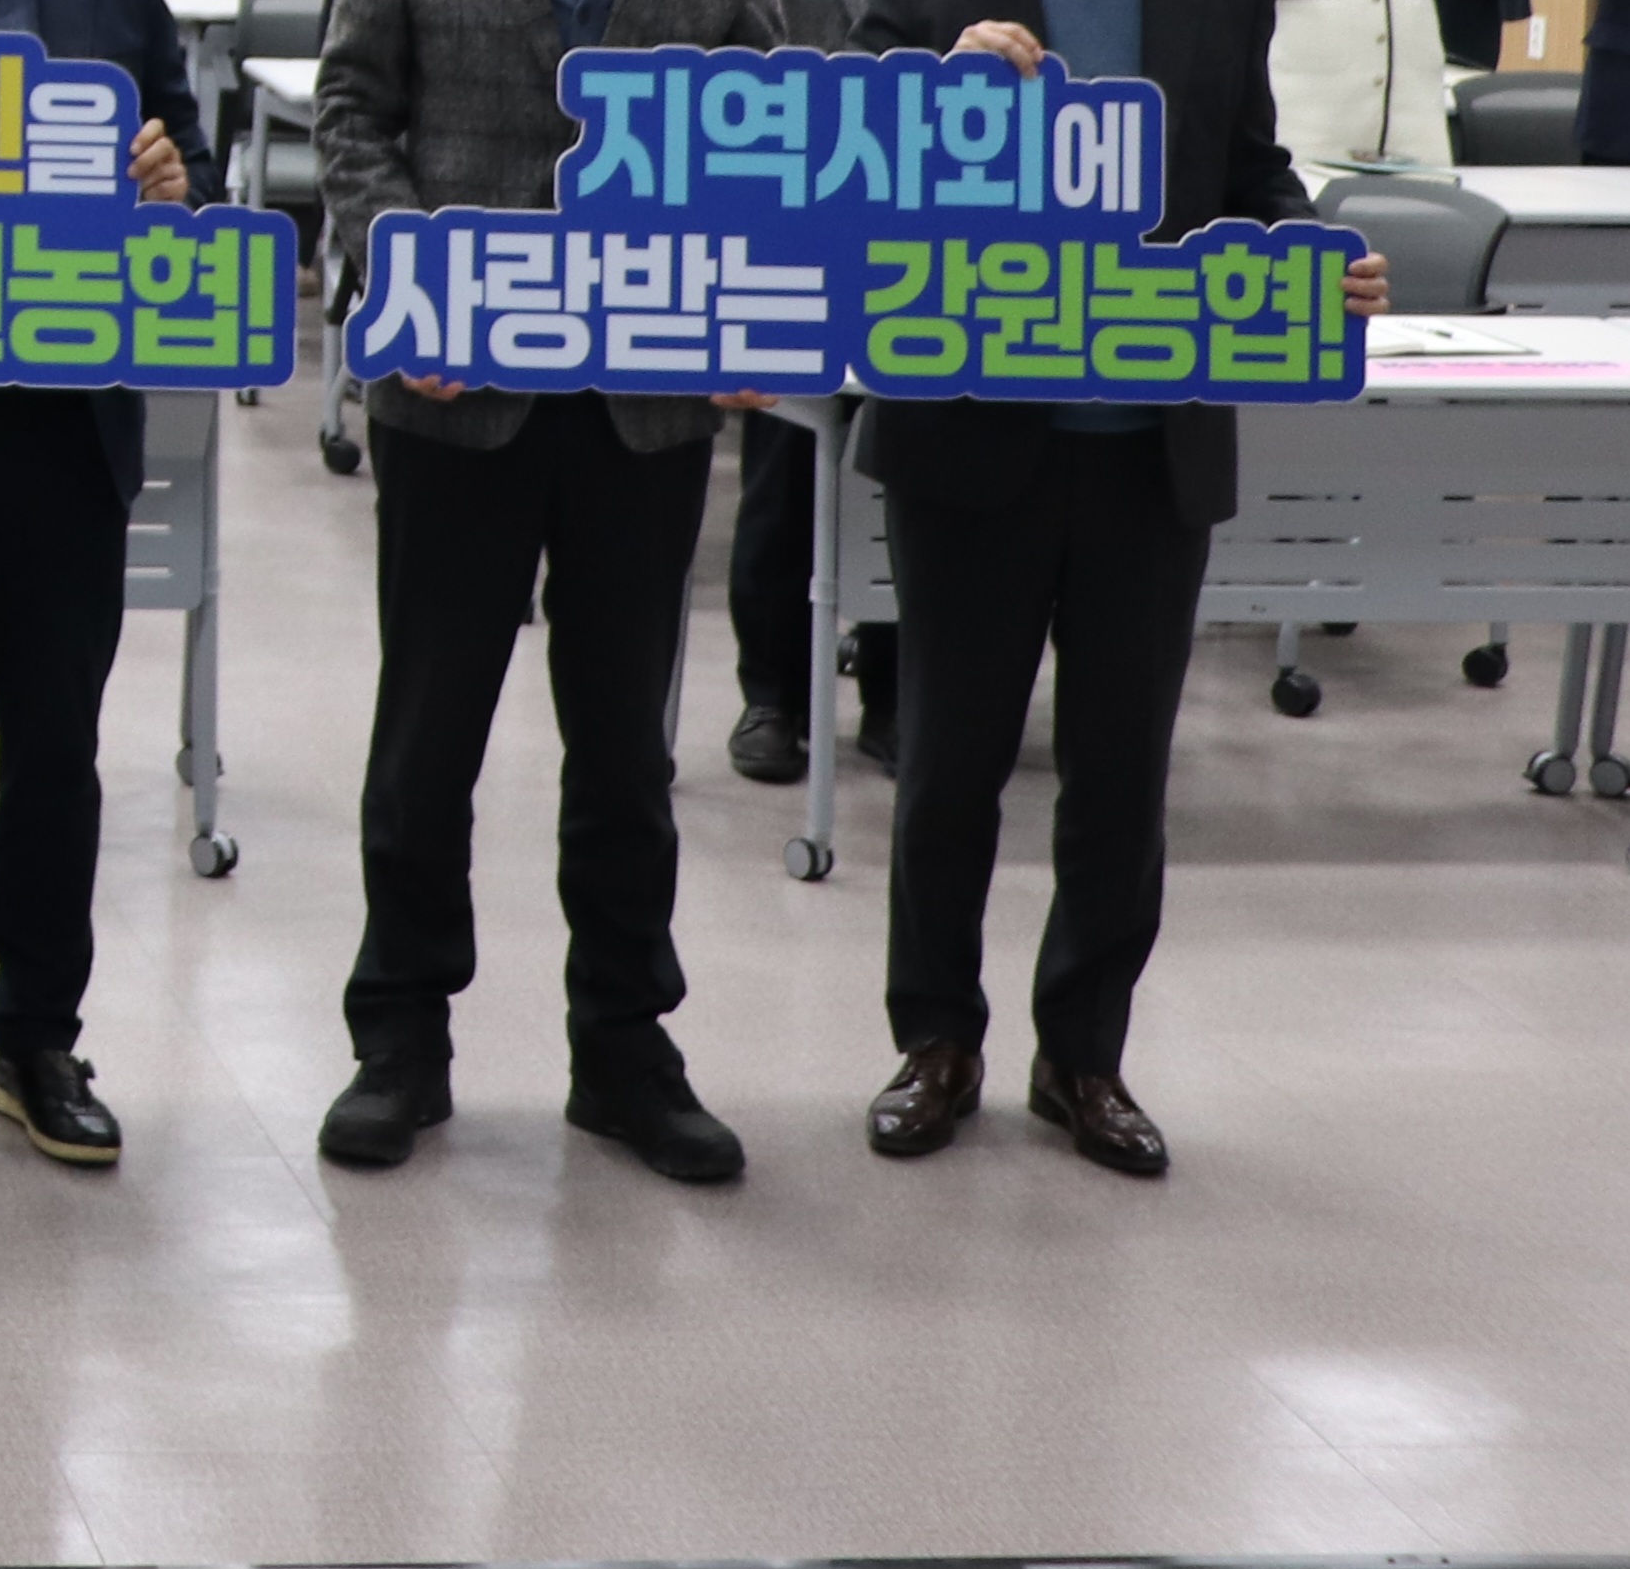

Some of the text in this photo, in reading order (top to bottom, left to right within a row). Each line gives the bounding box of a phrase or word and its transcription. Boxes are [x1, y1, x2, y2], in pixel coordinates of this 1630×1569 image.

[580, 68, 1140, 213] 지역사회에
[364, 229, 1345, 381] 사랑받는 강원농협!
